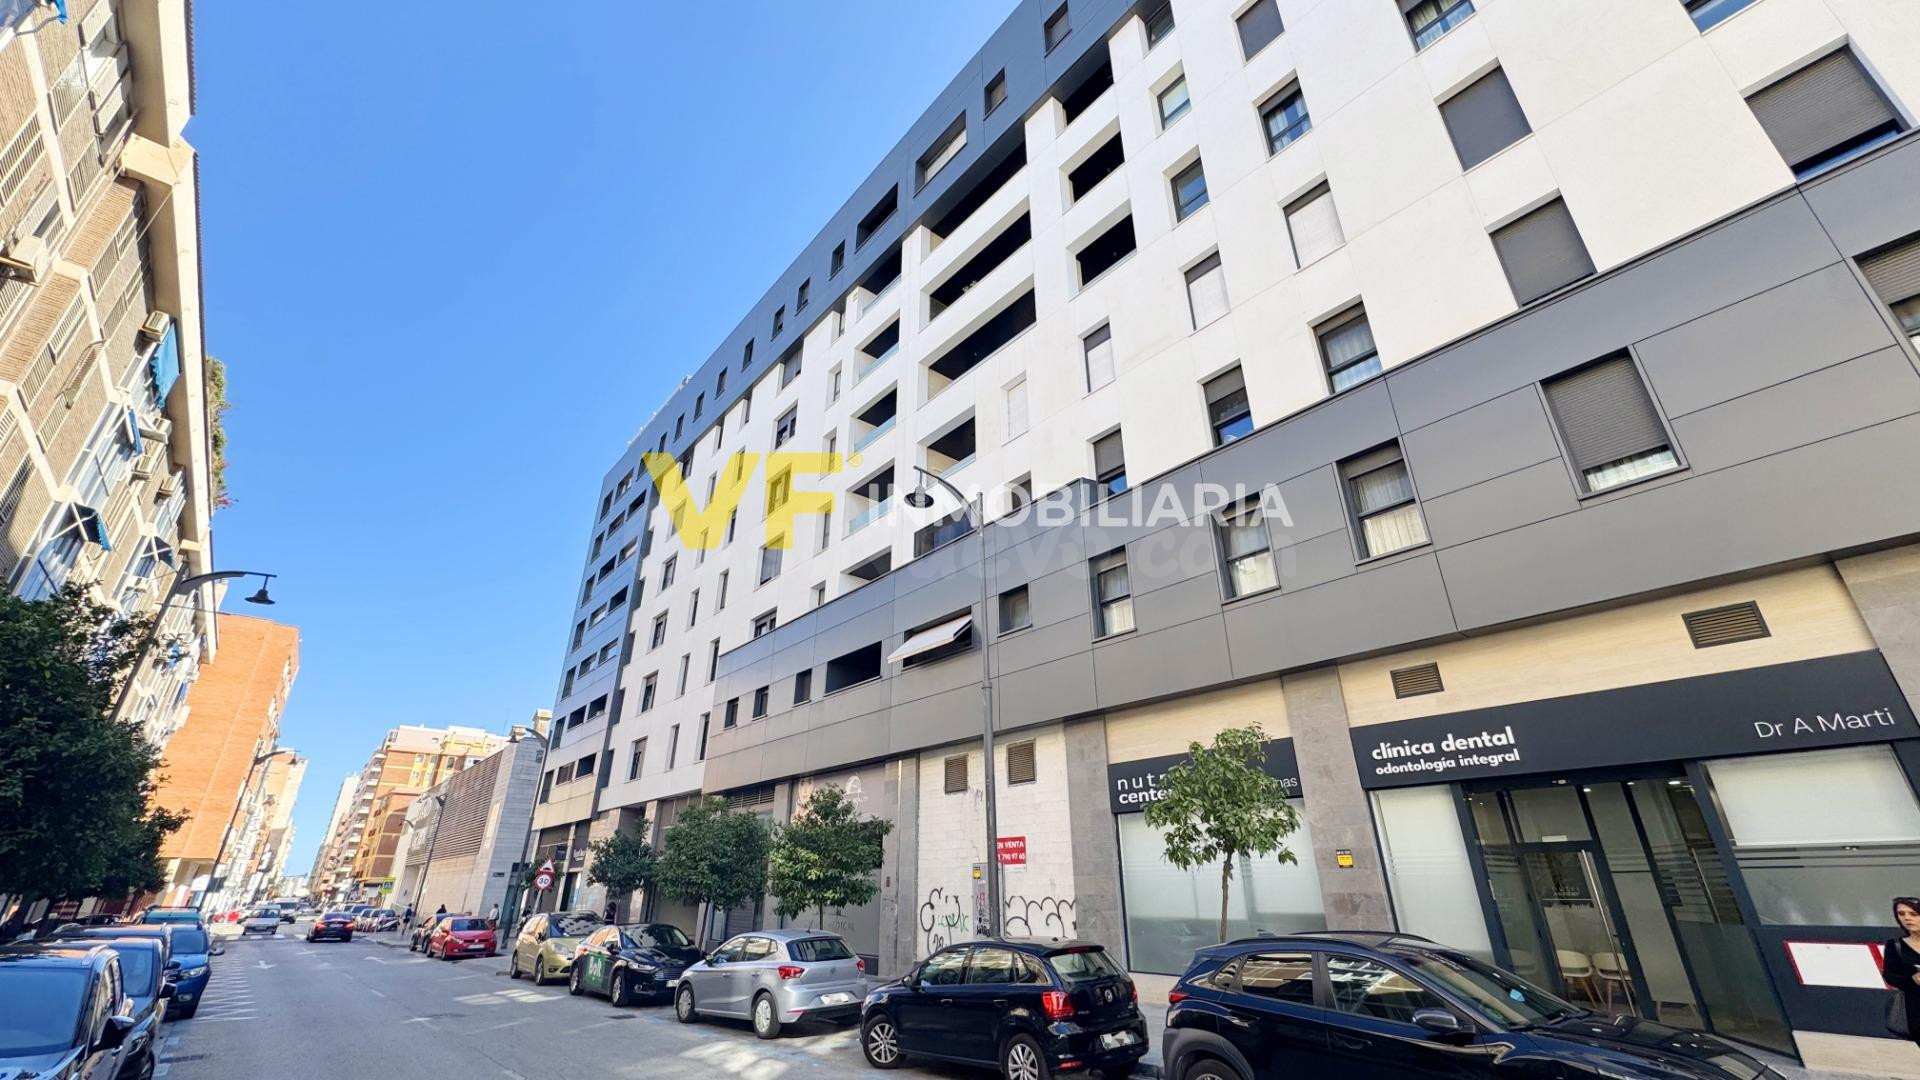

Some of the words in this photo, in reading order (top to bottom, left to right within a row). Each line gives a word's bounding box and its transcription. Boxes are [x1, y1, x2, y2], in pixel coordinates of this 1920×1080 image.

[1754, 721, 1784, 738] Dr
[1793, 717, 1814, 734] A
[1816, 707, 1896, 732] Marti
[1371, 739, 1436, 760] clínica
[1441, 725, 1515, 752] dental
[1375, 756, 1456, 775] odontología
[1458, 748, 1521, 767] integral
[1004, 840, 1024, 849] VENTA
[538, 877, 550, 885] 30
